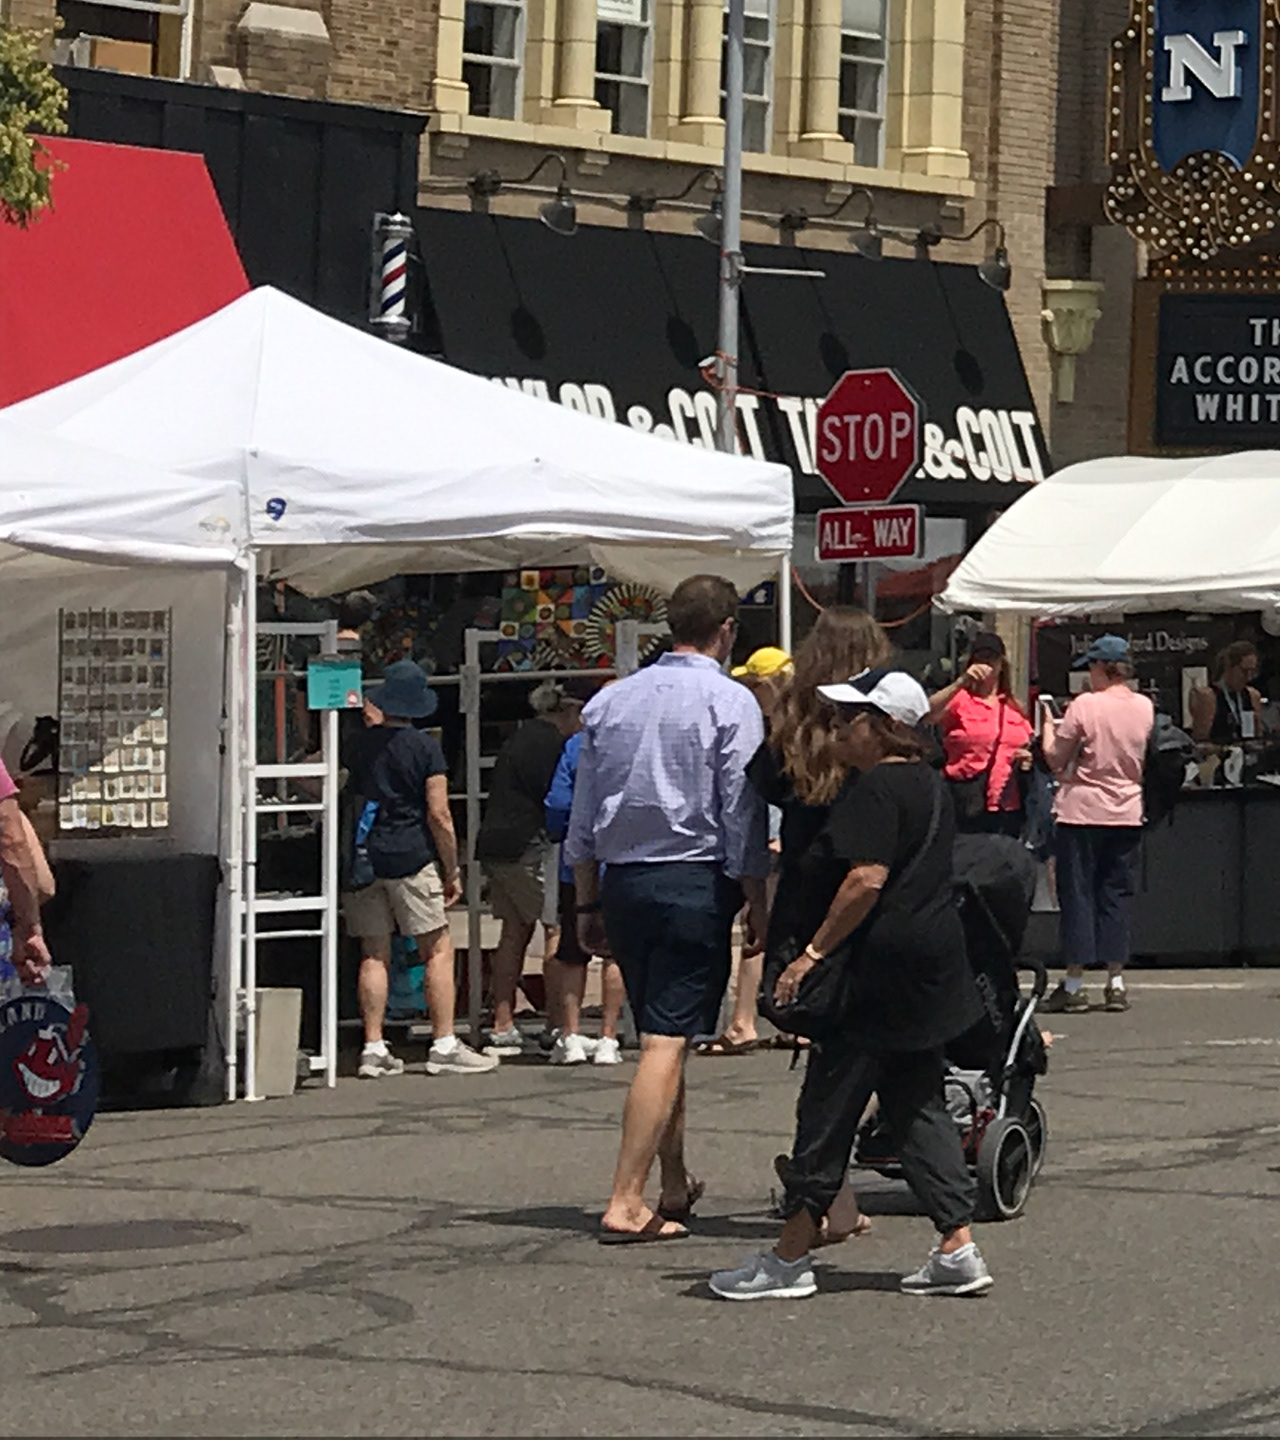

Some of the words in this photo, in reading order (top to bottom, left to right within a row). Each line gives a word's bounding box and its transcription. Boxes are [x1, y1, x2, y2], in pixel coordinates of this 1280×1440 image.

[821, 411, 912, 463] STOP
[956, 406, 1044, 483] COLT
[873, 517, 913, 548] WAY
[1155, 631, 1209, 654] Designs
